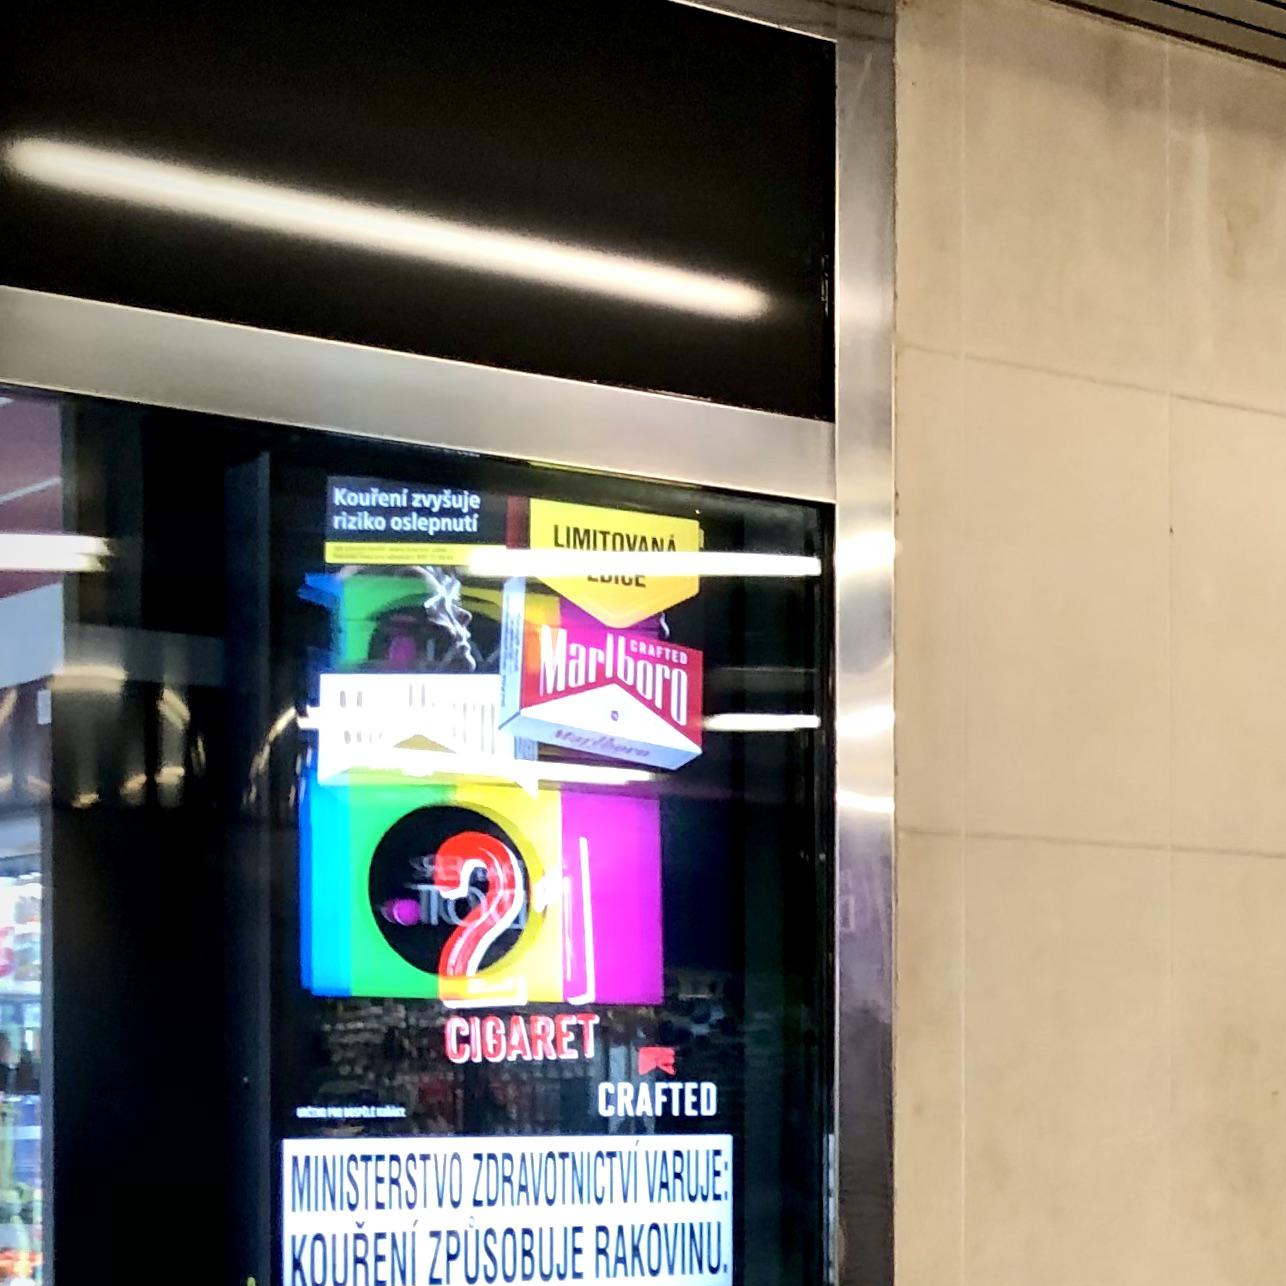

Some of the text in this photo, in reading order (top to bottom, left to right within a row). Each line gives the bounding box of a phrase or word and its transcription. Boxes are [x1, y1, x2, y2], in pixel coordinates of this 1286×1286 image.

[333, 486, 481, 513] Kouření zvyšuje
[332, 511, 480, 536] riziko oslepnutí
[629, 639, 688, 665] CRAFTED
[539, 624, 688, 727] Marlboro
[445, 1013, 600, 1064] CIGARET
[598, 1081, 717, 1117] CRAFTED
[291, 1139, 729, 1213] MINISTERSTVO ZDRAVOTNICTVÍ VARUJE:
[428, 1215, 584, 1286] ZPŮSOBUJE
[595, 1221, 729, 1280] RAKOVINU.
